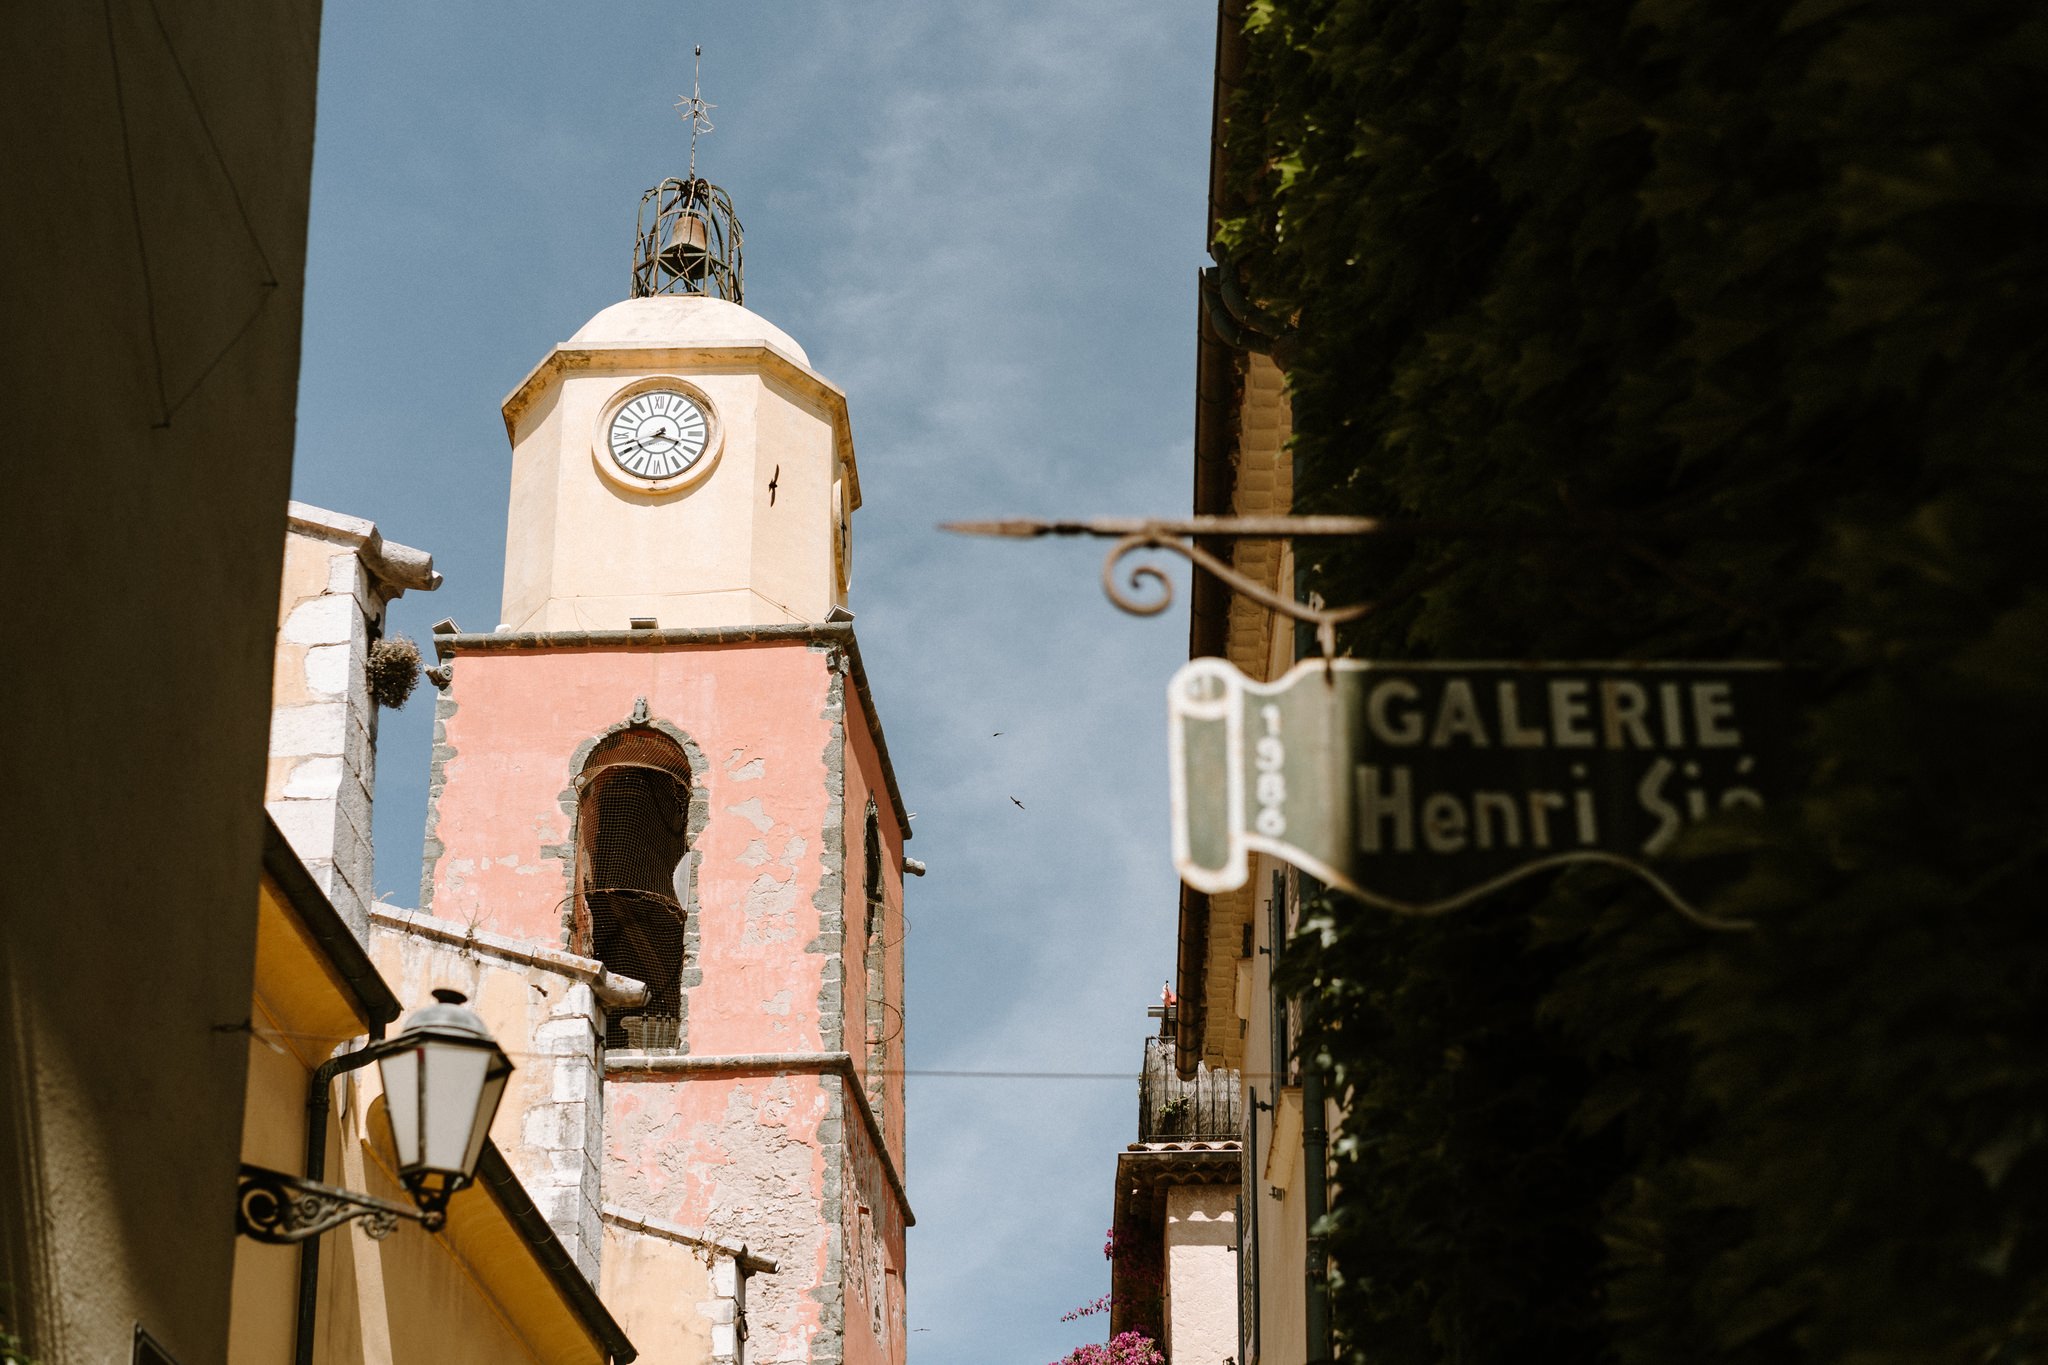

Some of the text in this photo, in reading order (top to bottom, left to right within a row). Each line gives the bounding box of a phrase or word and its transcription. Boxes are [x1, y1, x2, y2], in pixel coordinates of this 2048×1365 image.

[654, 396, 665, 409] XII
[1366, 677, 1744, 751] GALERIE
[1355, 762, 1599, 855] Henri
